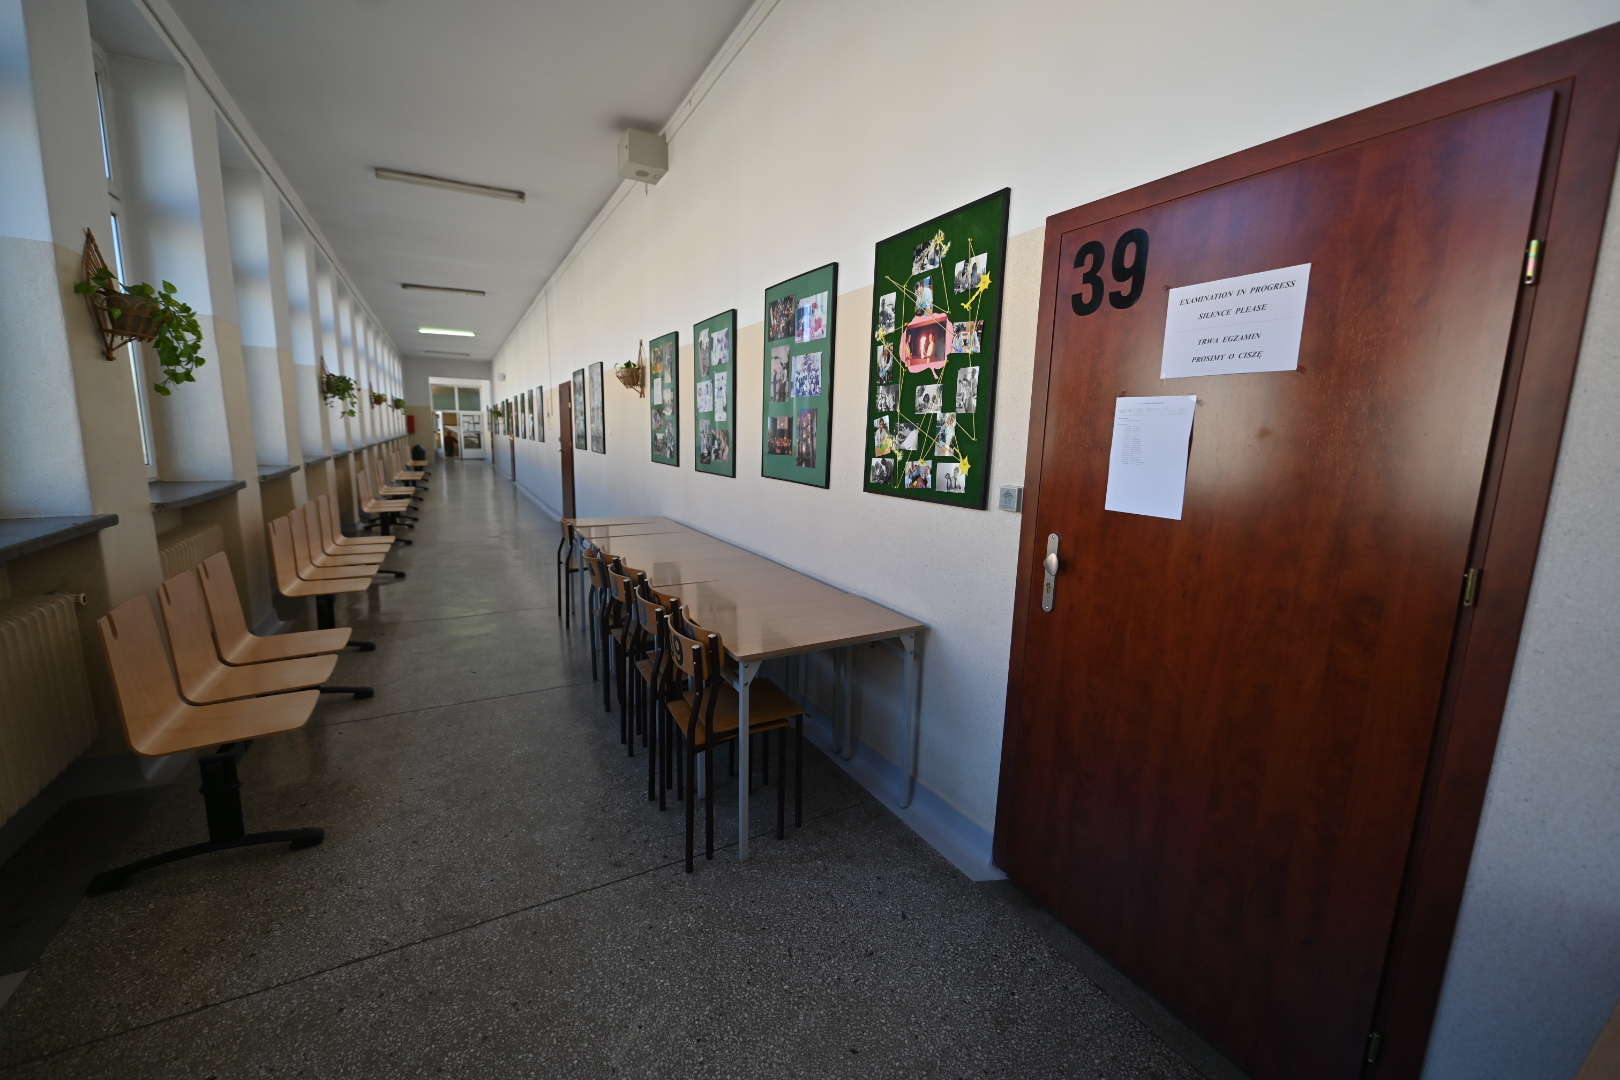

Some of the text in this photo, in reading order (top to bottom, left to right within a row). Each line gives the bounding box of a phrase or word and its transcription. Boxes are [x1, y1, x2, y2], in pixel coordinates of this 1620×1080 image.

[1071, 228, 1149, 316] 39
[1180, 280, 1297, 305] EXAMINATION IN PROGRESS
[1198, 304, 1267, 320] SILENCE PLEASE
[1222, 332, 1262, 343] EGZAMIN
[1191, 354, 1226, 363] PROSIMY
[1238, 351, 1263, 359] CISZĘ
